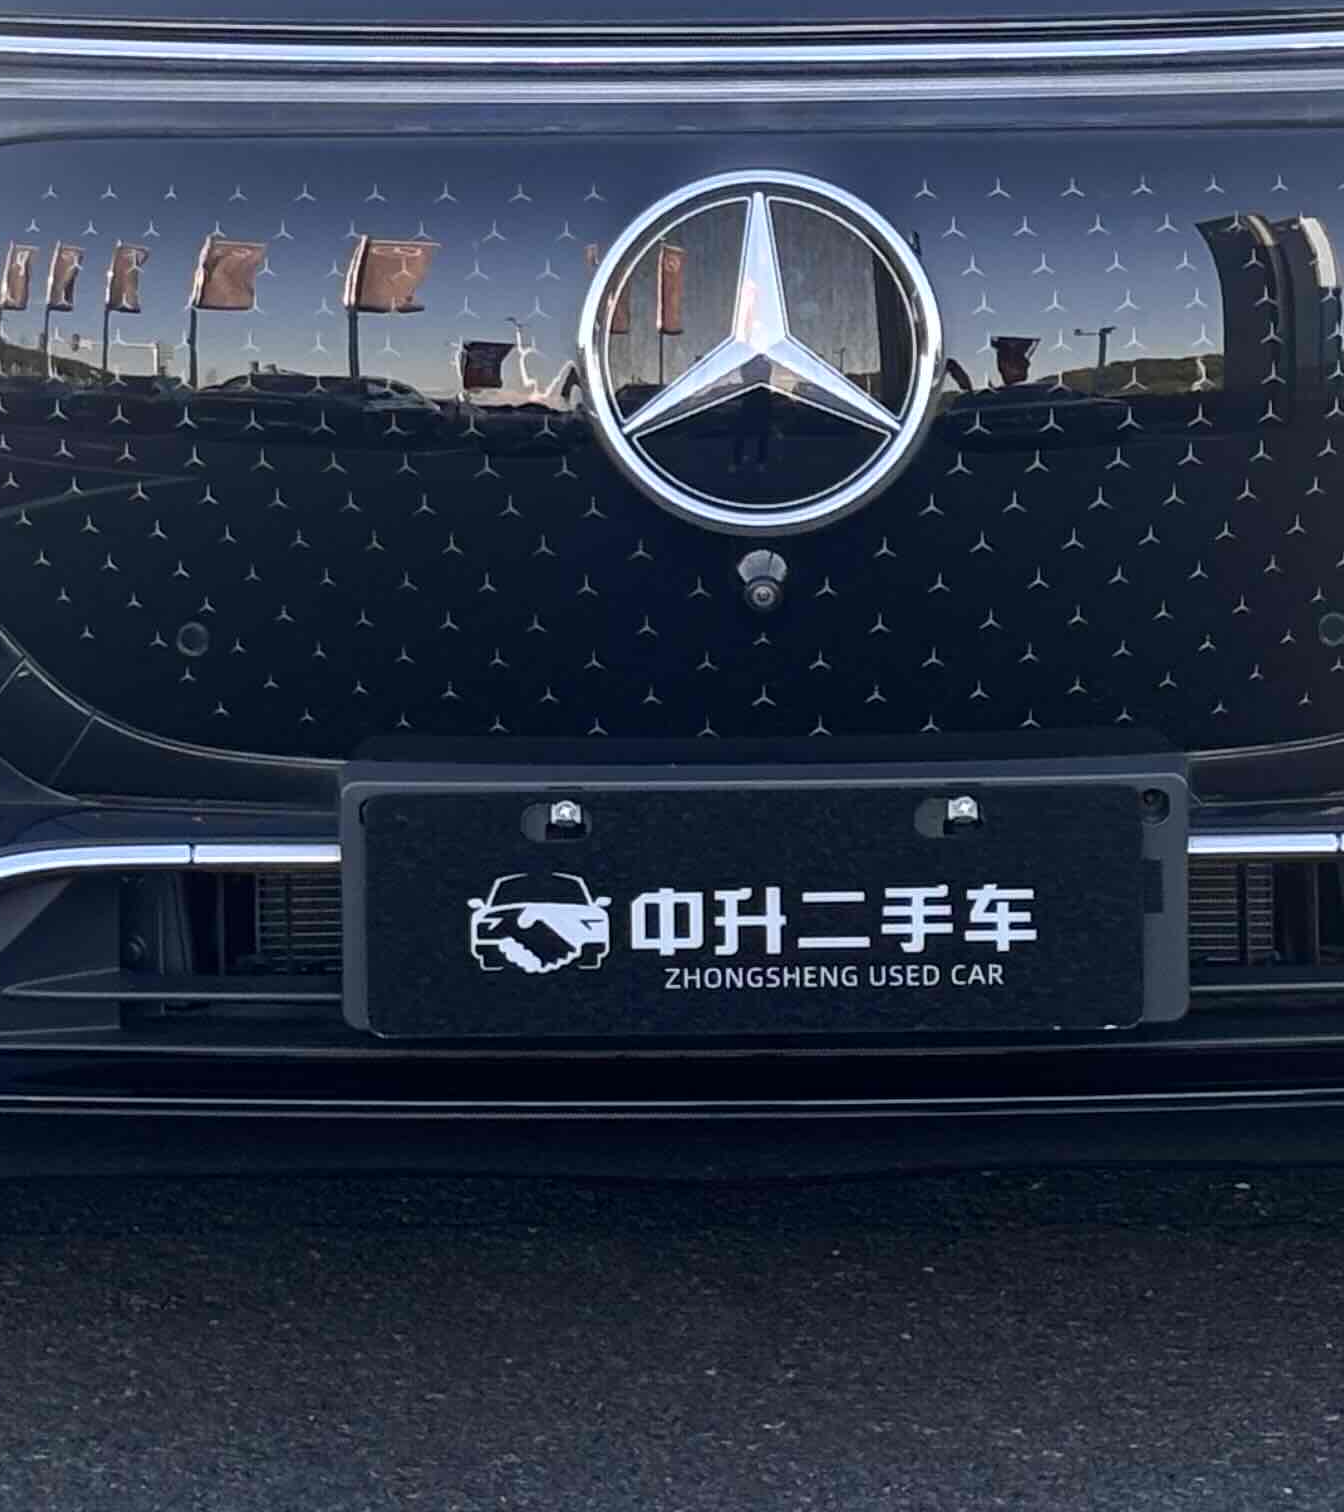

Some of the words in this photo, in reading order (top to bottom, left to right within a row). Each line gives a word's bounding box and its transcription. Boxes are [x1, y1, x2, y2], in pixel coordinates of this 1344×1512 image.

[630, 883, 1038, 956] 中升二手车
[664, 965, 859, 990] ZHONGSHENG
[869, 964, 941, 987] USED
[950, 963, 1006, 986] CAR
